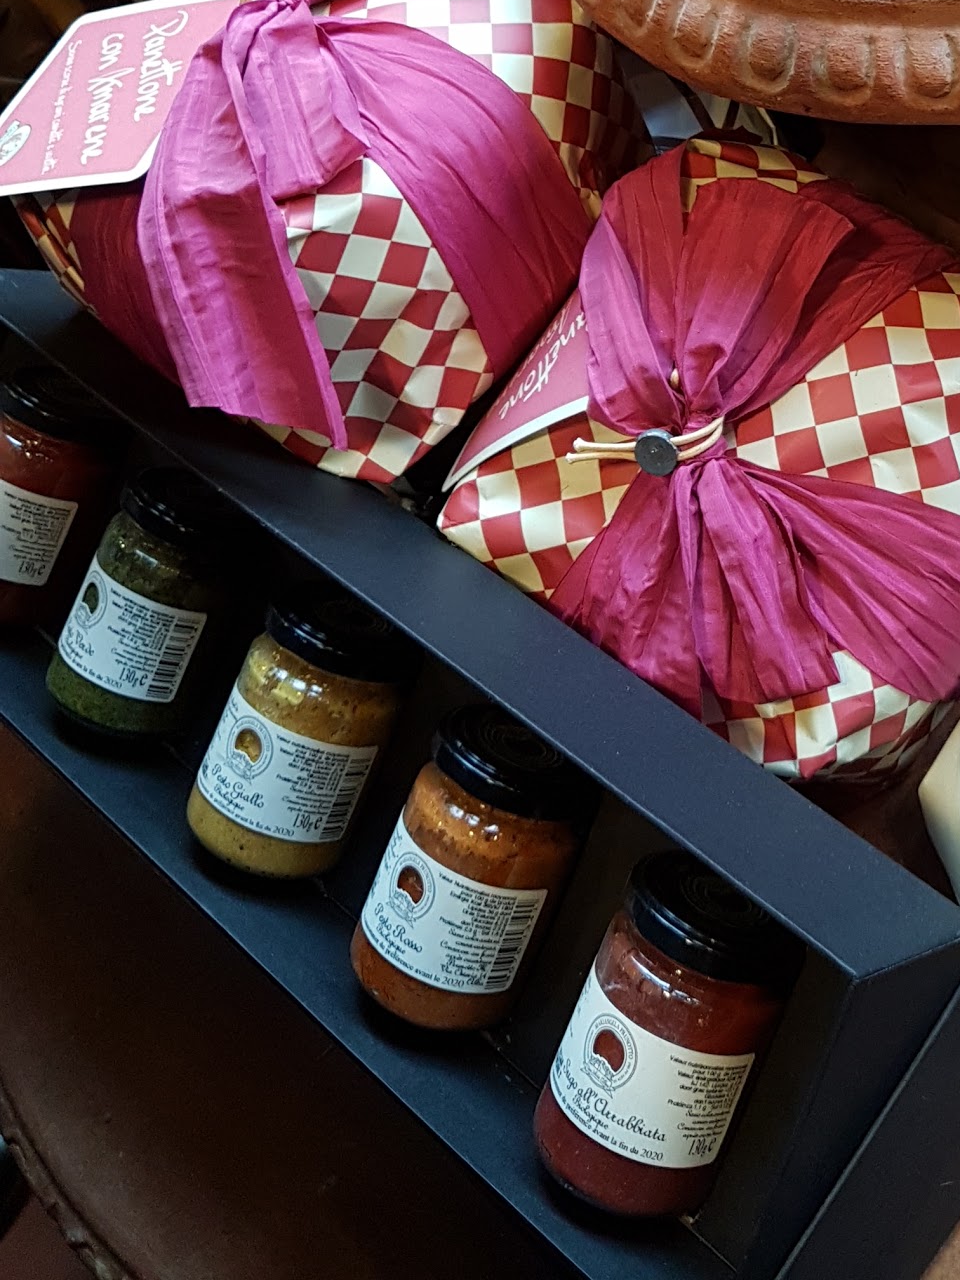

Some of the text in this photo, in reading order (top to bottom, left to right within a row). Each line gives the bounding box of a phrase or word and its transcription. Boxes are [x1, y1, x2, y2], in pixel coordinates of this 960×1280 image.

[97, 32, 125, 71] con
[133, 9, 189, 123] Panettone
[498, 311, 587, 420] anettone
[271, 824, 295, 838] 2020
[440, 974, 465, 988] 2020
[562, 1058, 578, 1090] Sugo
[640, 1148, 664, 1162] 2020
